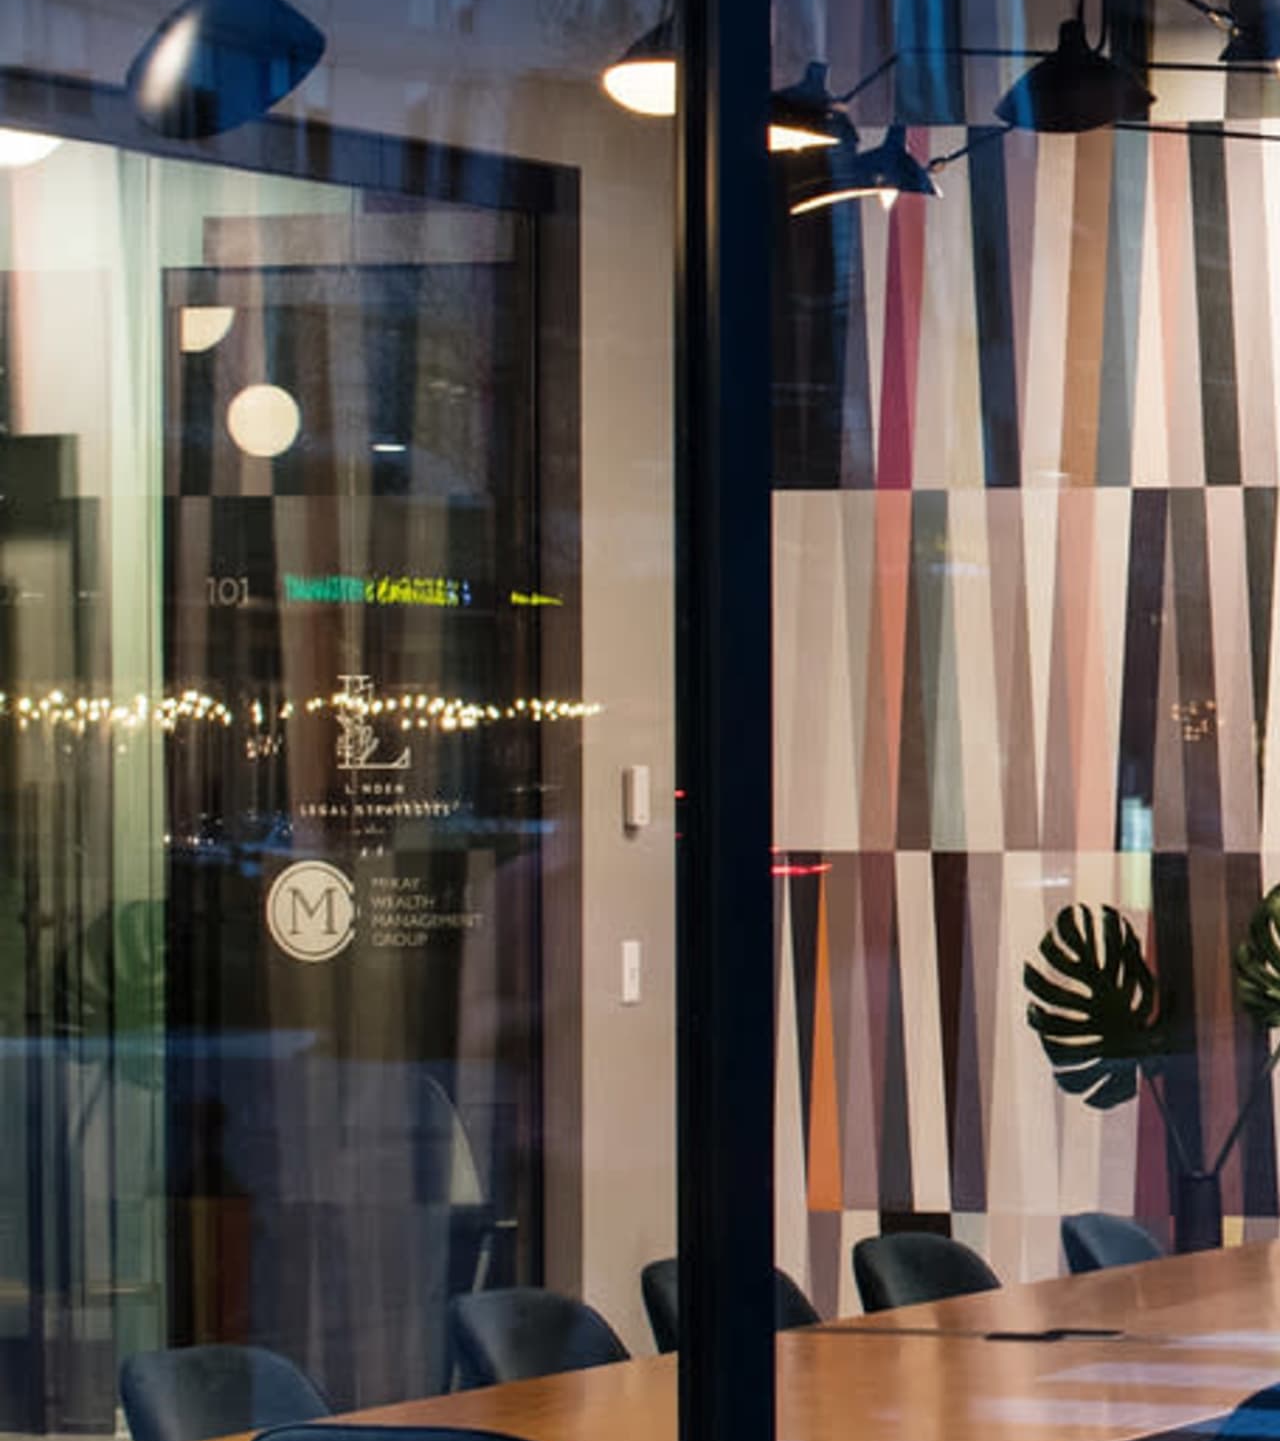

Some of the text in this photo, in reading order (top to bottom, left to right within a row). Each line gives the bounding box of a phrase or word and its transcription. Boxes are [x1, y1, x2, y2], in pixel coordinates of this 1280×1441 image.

[205, 577, 250, 606] 101
[345, 783, 404, 795] LNDEN
[301, 803, 348, 817] LEGAL
[370, 894, 435, 909] WEALTH
[370, 913, 482, 929] MANAGEMENT
[371, 932, 427, 947] GROUP
